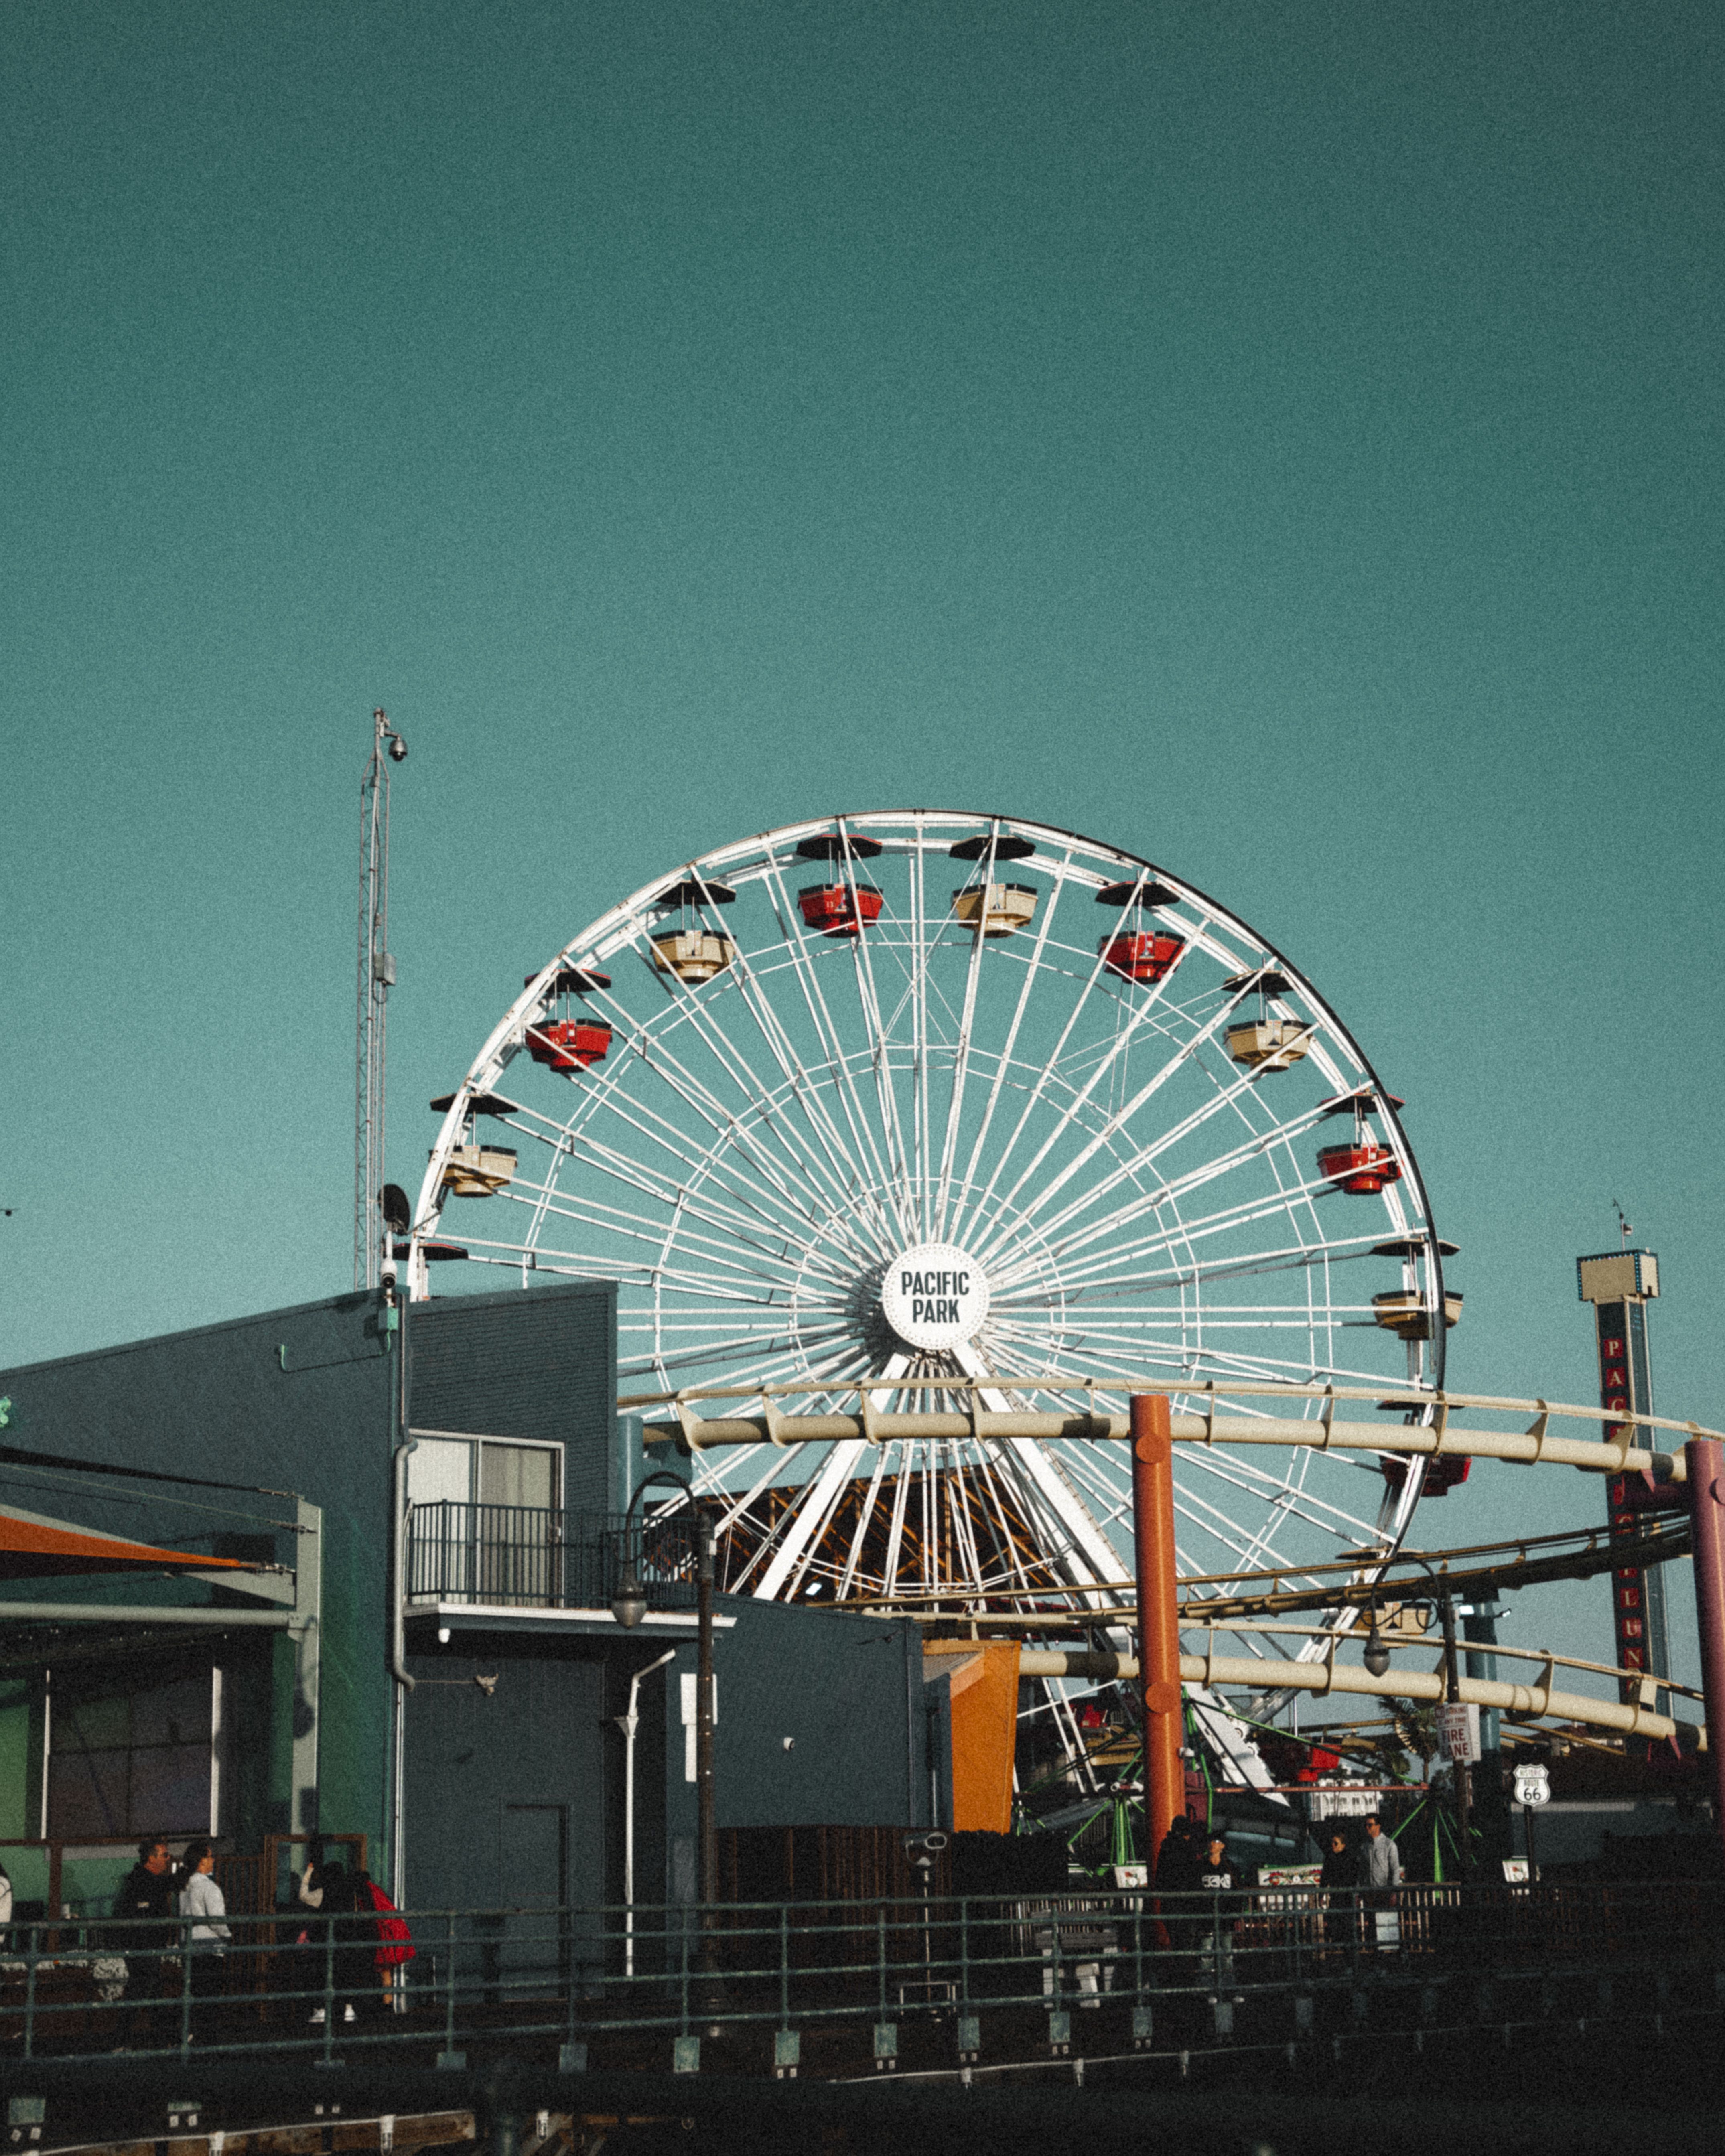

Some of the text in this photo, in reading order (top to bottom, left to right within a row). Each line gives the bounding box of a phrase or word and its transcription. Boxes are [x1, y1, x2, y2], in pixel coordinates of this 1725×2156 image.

[901, 1271, 969, 1296] PACIFIC
[912, 1299, 960, 1323] PARK
[1442, 1728, 1465, 1743] FIRE
[1524, 1788, 1541, 1801] 66
